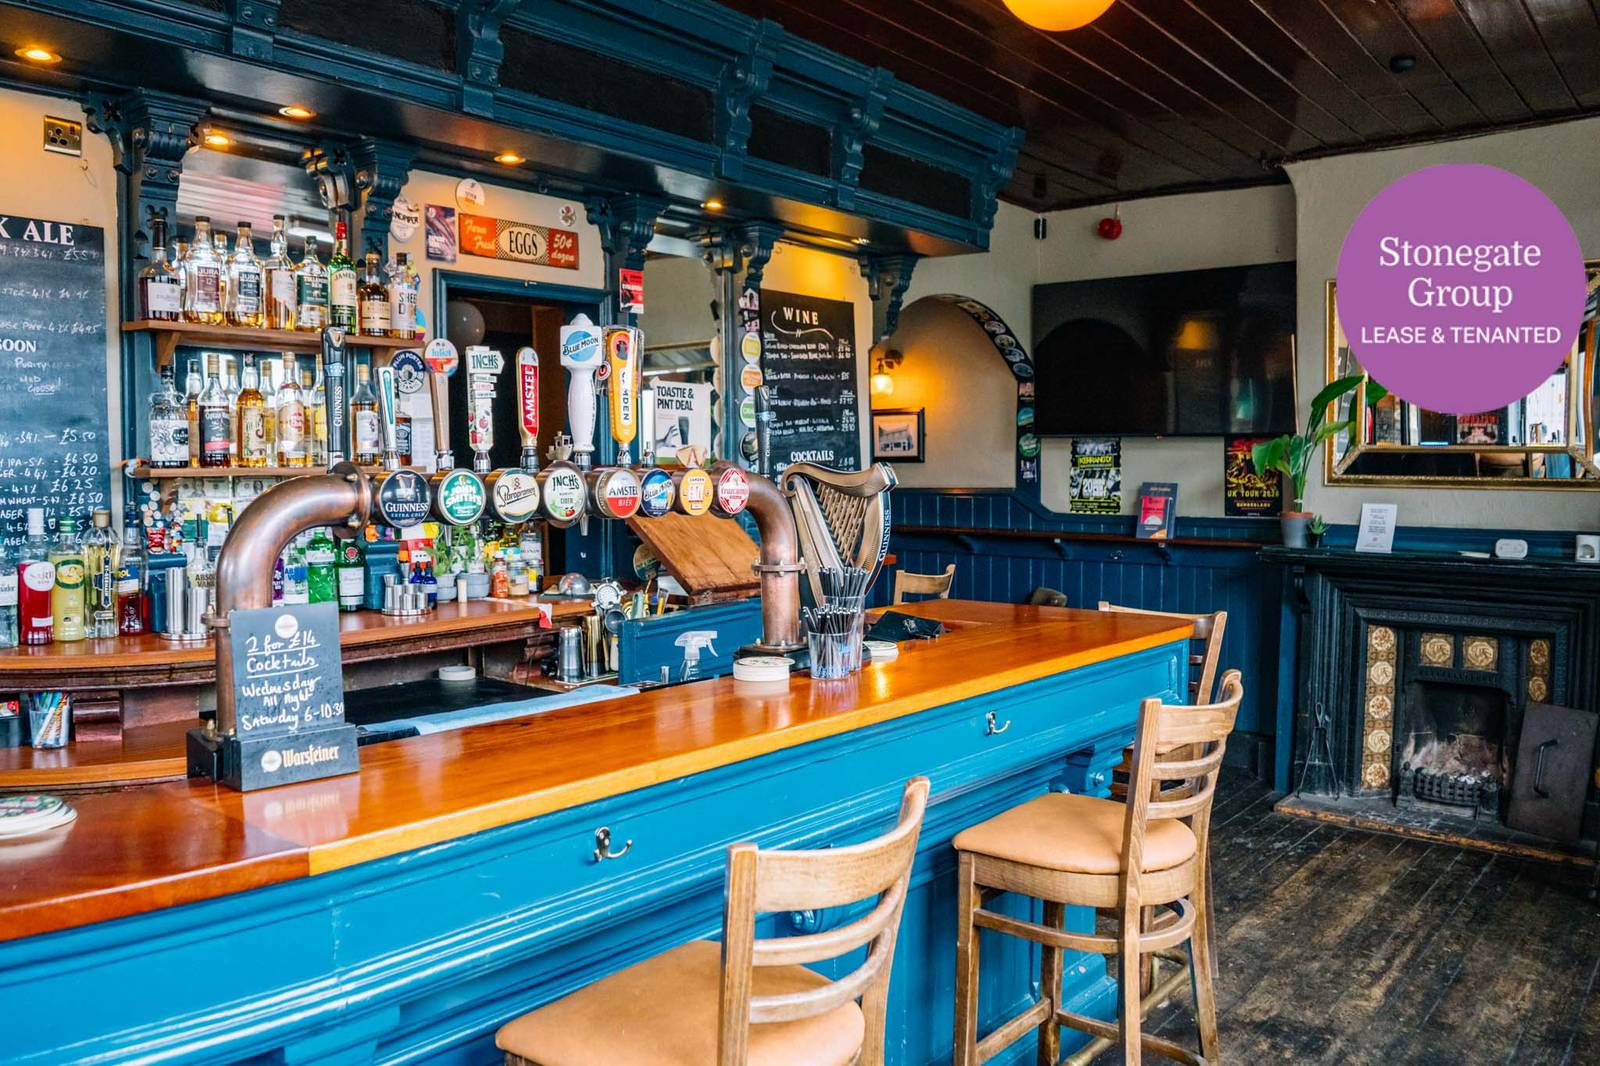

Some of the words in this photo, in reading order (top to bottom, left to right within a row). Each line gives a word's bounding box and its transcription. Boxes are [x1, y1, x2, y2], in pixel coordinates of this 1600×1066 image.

[23, 220, 75, 246] ALE
[463, 219, 487, 234] Farm
[509, 231, 538, 256] EGGS
[783, 306, 819, 326] WINE
[562, 344, 580, 356] BLUE
[580, 337, 600, 349] MOON
[524, 366, 536, 424] AMSTEL
[656, 385, 686, 399] TOASTIE
[687, 387, 695, 399] &
[334, 385, 344, 427] GUINNESS
[657, 398, 674, 411] PINT
[675, 399, 694, 412] DEAL
[790, 450, 835, 463] COCKTAILS
[450, 485, 477, 496] JOHN
[1227, 490, 1237, 498] UK
[1241, 490, 1259, 498] TOUR
[0, 508, 24, 519] AGER
[385, 502, 429, 513] GUINNESS
[3, 535, 28, 546] AGER
[878, 508, 891, 562] GUINNESS
[246, 635, 258, 652] 2
[264, 634, 285, 655] for
[288, 629, 317, 649] £14
[246, 650, 316, 674] Cocktails
[241, 674, 321, 698] Wednesday
[263, 695, 278, 708] All
[241, 710, 299, 732] Saturday
[282, 744, 340, 768] Warsteiner
